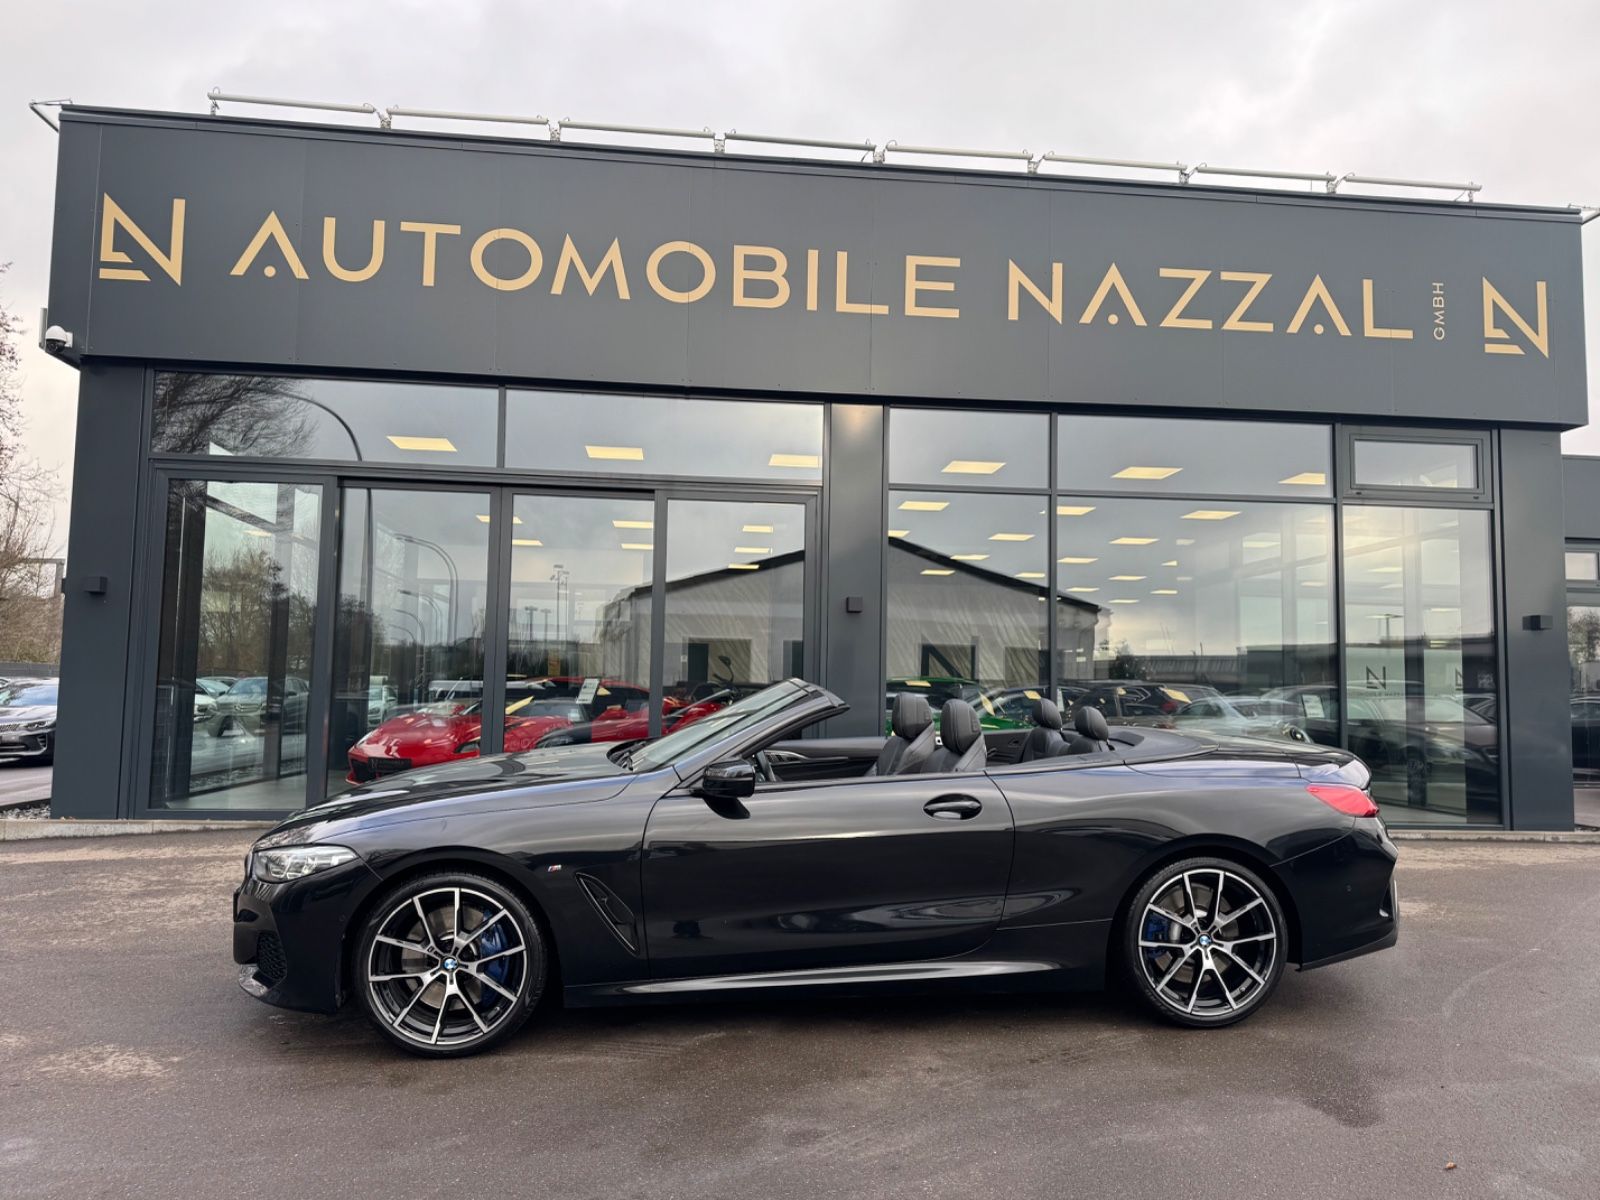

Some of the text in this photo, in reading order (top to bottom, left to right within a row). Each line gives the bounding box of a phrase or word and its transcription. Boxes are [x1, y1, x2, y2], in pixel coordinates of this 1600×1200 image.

[230, 210, 1414, 340] AUTOMOBILE NAZZAL
[1431, 281, 1447, 342] GMBH
